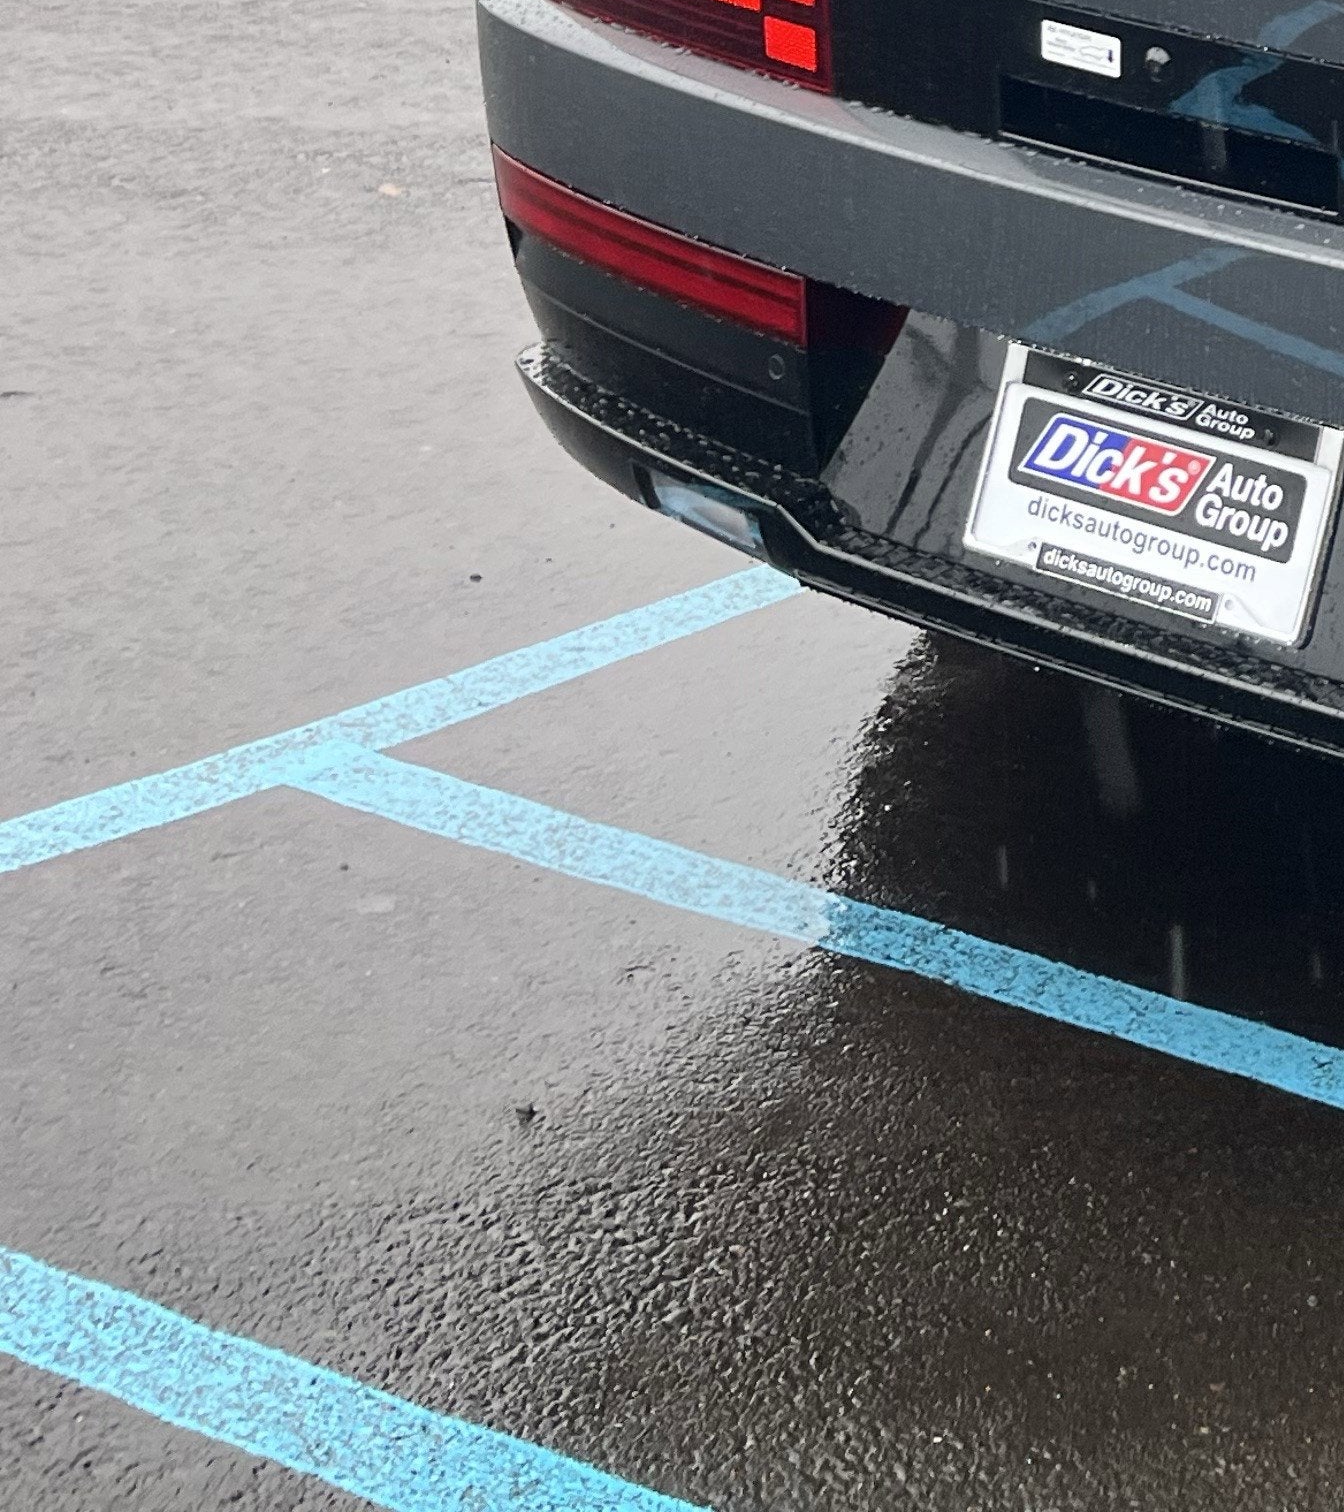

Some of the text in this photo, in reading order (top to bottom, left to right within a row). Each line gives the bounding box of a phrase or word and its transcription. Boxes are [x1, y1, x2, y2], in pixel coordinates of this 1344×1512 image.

[1092, 377, 1193, 418] Dick's
[1202, 403, 1249, 425] Auto
[1196, 414, 1256, 440] Group
[1033, 423, 1190, 504] Dick's
[1207, 463, 1283, 511] Auto
[1027, 496, 1257, 583] dicksautogroup.com
[1196, 494, 1289, 552] Group
[1042, 547, 1213, 613] dicksautogroup.com
